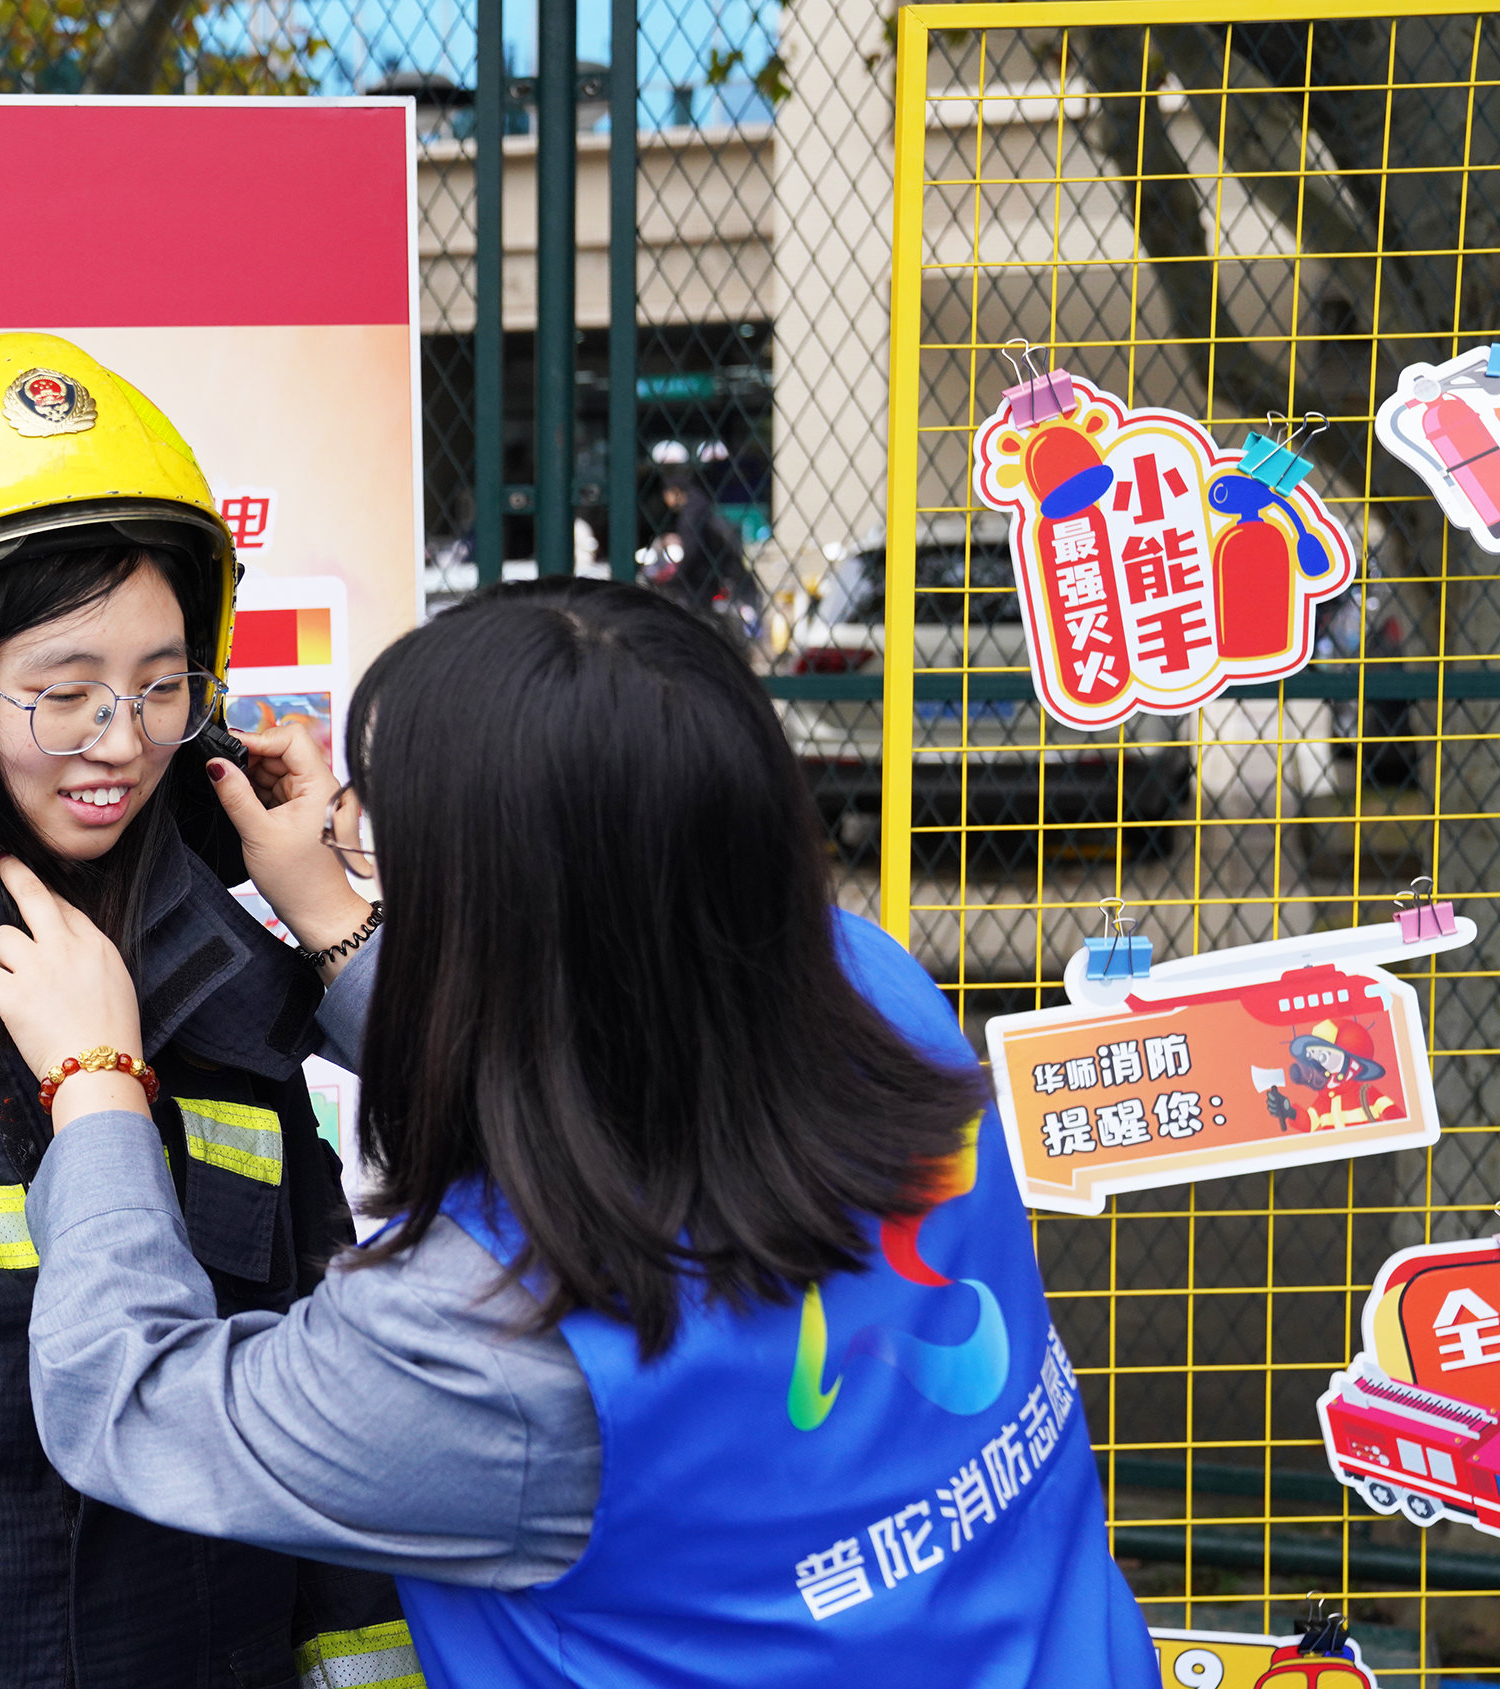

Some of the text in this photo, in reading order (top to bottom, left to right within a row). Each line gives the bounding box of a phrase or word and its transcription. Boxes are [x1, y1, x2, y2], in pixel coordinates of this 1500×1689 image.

[1051, 517, 1120, 694] 最强灭火
[1113, 453, 1213, 674] 小能手
[1033, 1033, 1191, 1094] 华师消防
[1432, 1288, 1500, 1371] 全
